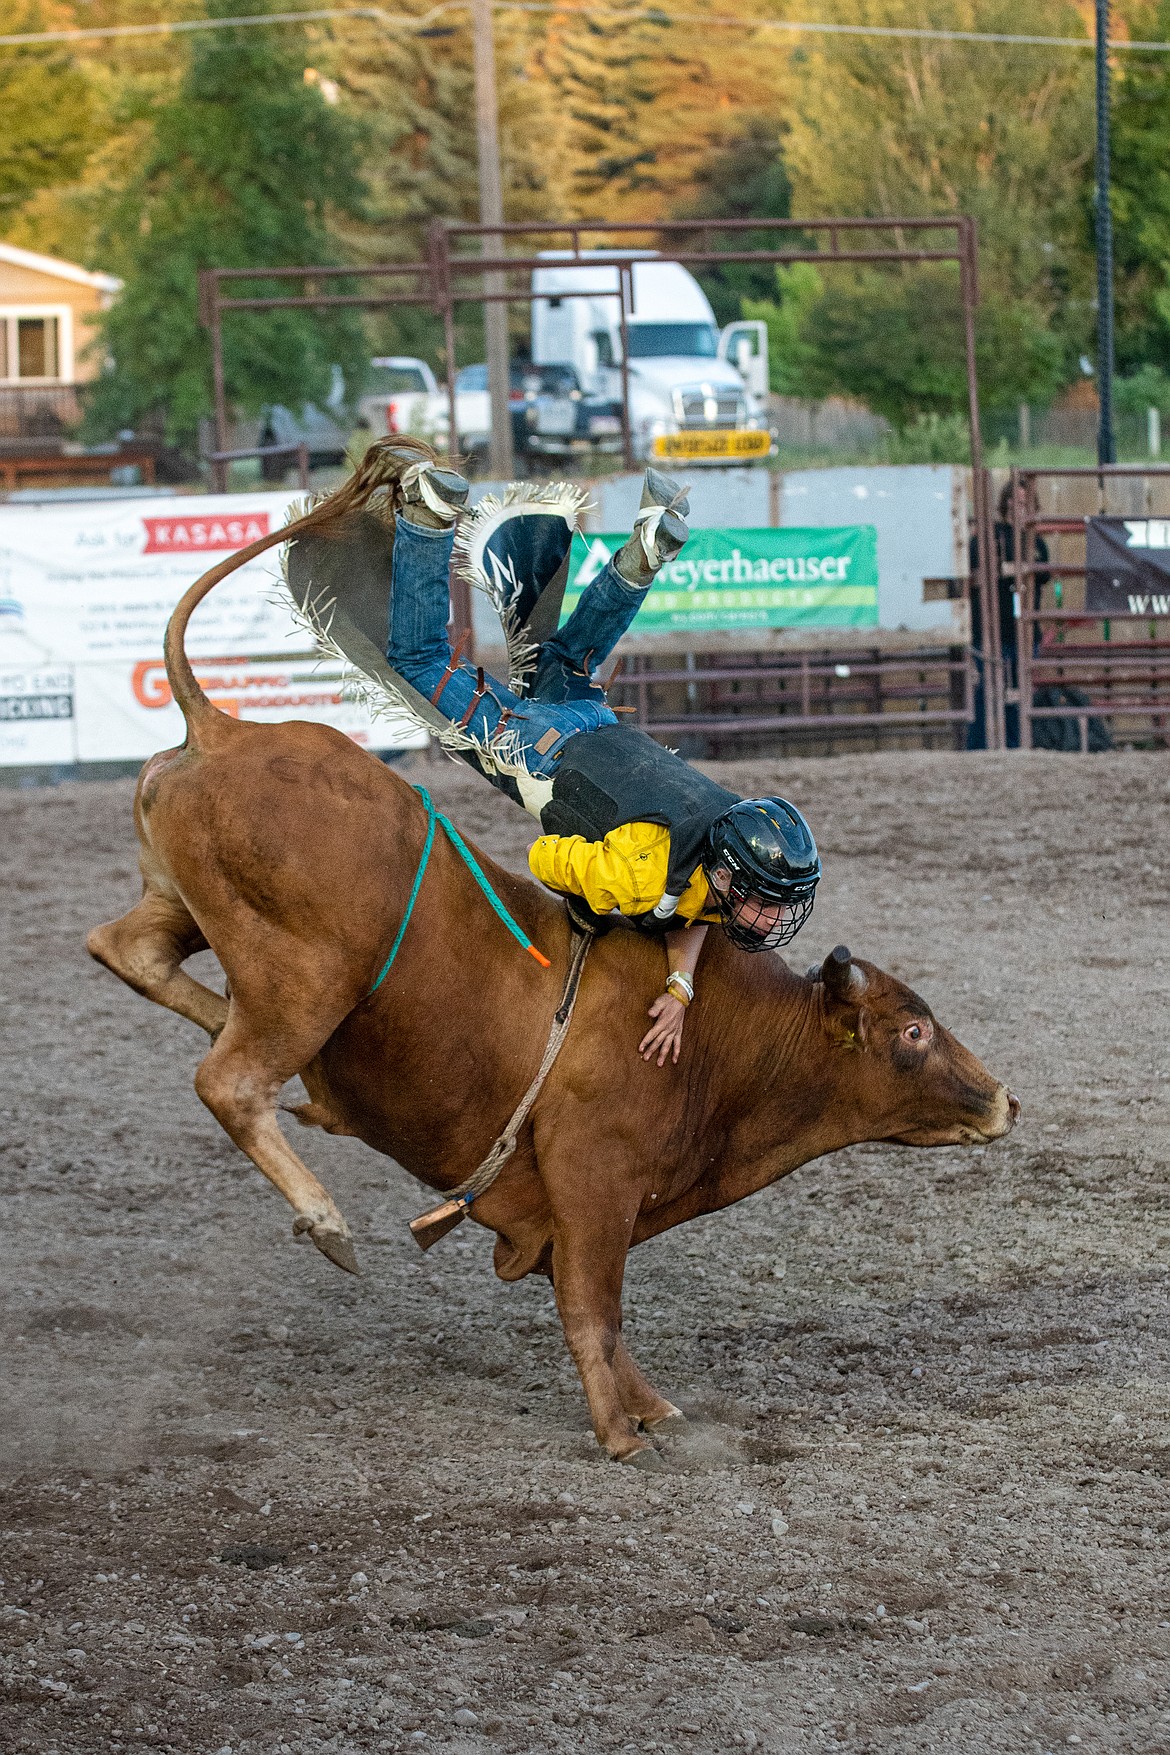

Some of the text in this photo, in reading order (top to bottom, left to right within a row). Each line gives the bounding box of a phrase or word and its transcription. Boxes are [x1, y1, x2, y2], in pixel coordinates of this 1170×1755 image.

[154, 520, 264, 545] KASASA
[692, 590, 815, 607] PRODUCTS
[722, 848, 741, 871] CCM
